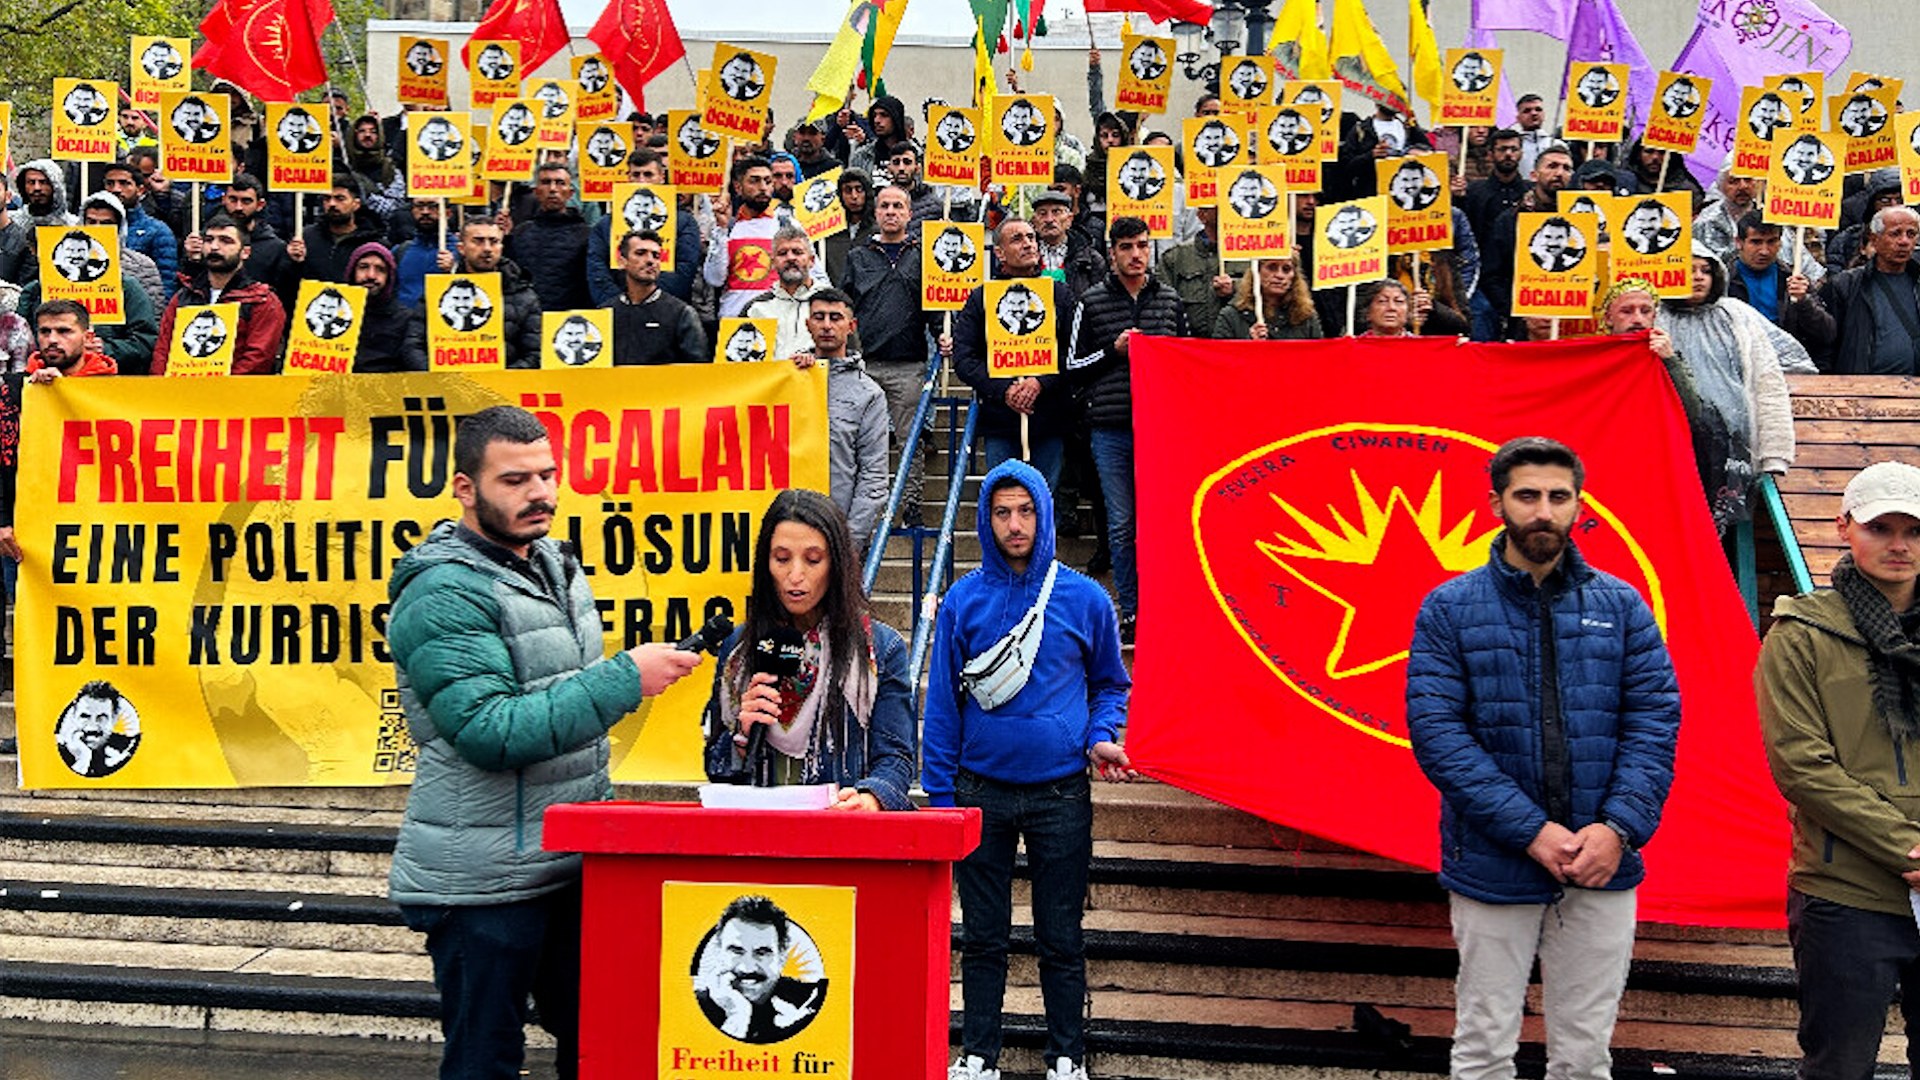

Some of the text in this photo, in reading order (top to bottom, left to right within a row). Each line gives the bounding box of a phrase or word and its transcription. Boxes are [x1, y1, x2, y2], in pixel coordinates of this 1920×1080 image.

[706, 107, 760, 133] ÖCALAN
[1568, 117, 1618, 134] ÖCALAN
[57, 137, 110, 153] ÖCALAN
[1647, 125, 1694, 147] ÖCALAN
[167, 155, 226, 173] ÖCALAN
[995, 159, 1049, 176] ÖCALAN
[273, 166, 326, 183] ÖCALAN
[413, 175, 466, 189] ÖCALAN
[674, 170, 723, 186] ÖCALAN
[1771, 196, 1834, 218] ÖCALAN
[1224, 234, 1284, 250] ÖCALAN
[1388, 225, 1447, 244] ÖCALAN
[1318, 259, 1380, 280] ÖCALAN
[1519, 288, 1587, 306] ÖCALAN
[290, 351, 348, 373] ÖCALAN
[435, 348, 498, 366] ÖCALAN
[993, 350, 1051, 369] ÖCALAN
[1331, 433, 1449, 454] CIWANÊN
[58, 417, 344, 503] FREIHEIT
[52, 523, 180, 583] EINE
[568, 502, 752, 576] LÖSUN
[53, 606, 157, 666] DER
[188, 603, 395, 665] KURDIS
[672, 1047, 835, 1074] Freiheit für
